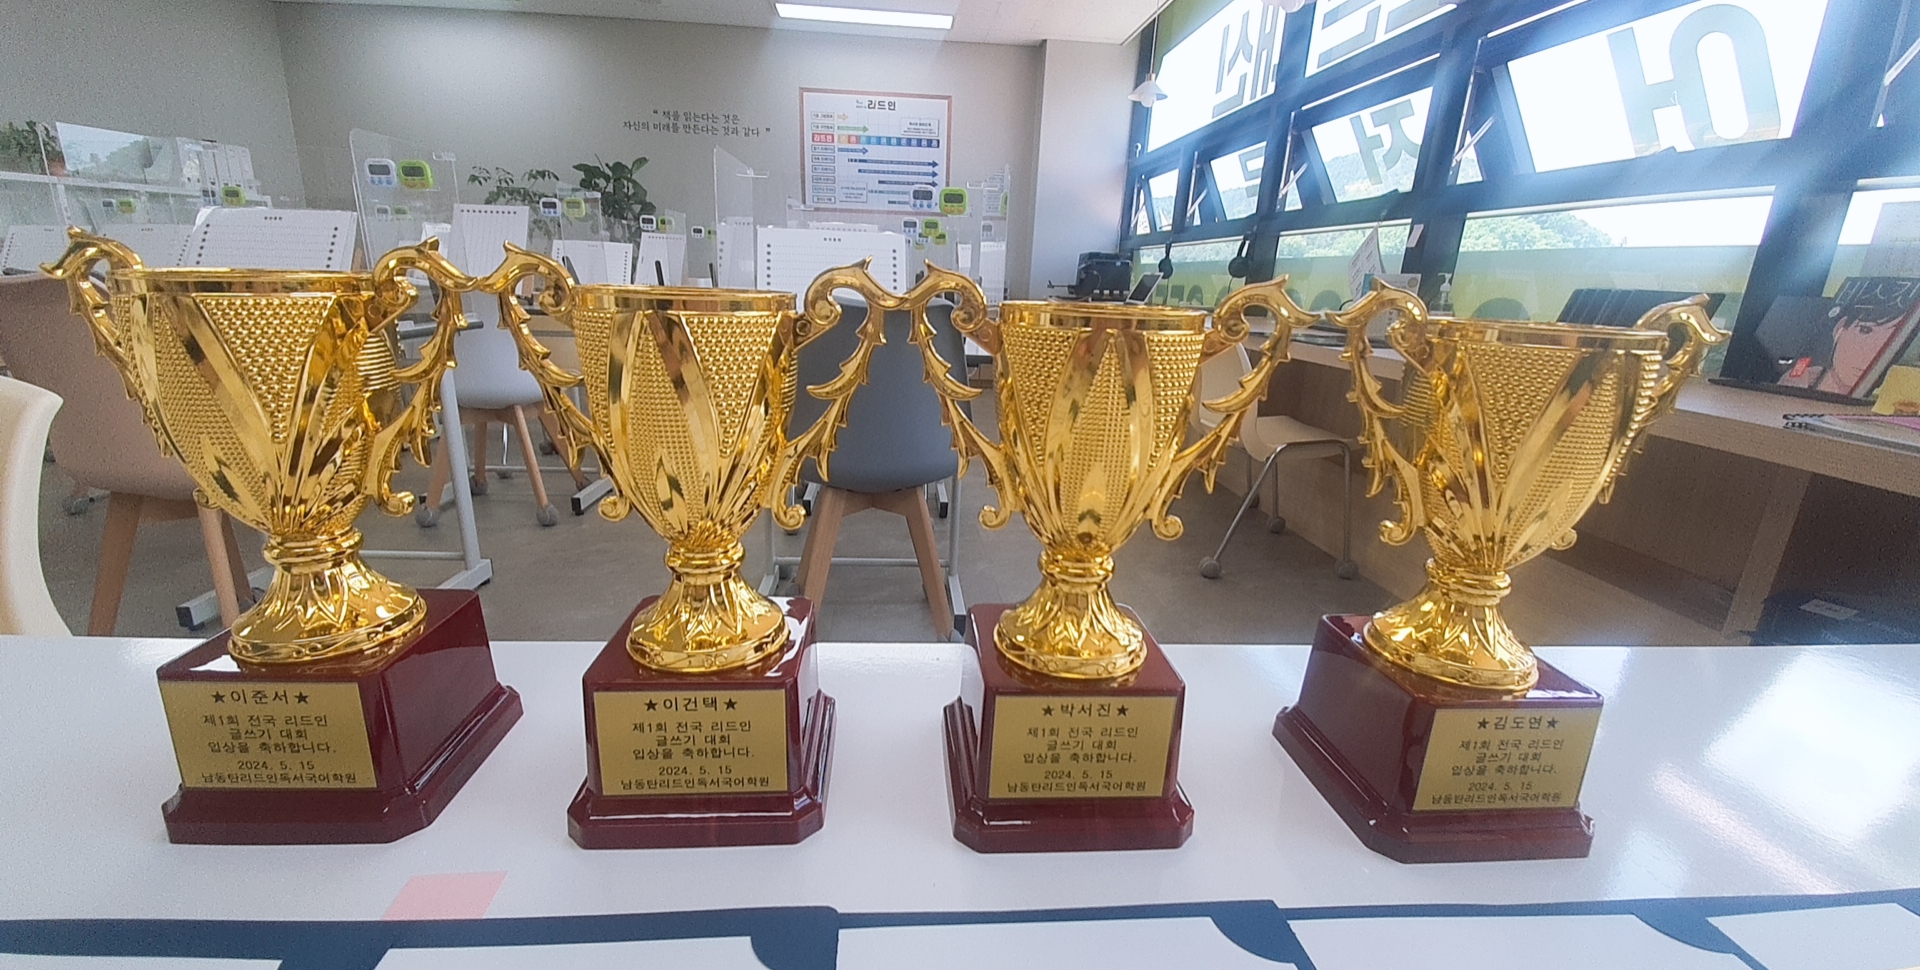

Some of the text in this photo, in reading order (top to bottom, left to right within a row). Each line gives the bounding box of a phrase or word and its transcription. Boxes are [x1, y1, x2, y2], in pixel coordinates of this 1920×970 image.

[867, 100, 896, 111] 리드인
[662, 110, 680, 122] 책을
[683, 112, 720, 124] 읽는다는
[722, 114, 740, 125] 것은
[622, 120, 650, 132] 자신의
[652, 122, 680, 134] 미래를
[682, 124, 720, 136] 만든다는
[722, 126, 739, 137] 것과
[742, 126, 760, 138] 같다
[230, 689, 290, 705] 이준서
[663, 696, 718, 712] 이건택
[1060, 703, 1112, 718] 박서진
[203, 714, 328, 728] 제1회 전국 리드인
[632, 720, 752, 734] 제1회 전국 리드인
[1494, 716, 1542, 730] 김도연
[229, 728, 308, 740] 글쓰기 대회
[1027, 727, 1140, 738] 제1회 전국 리드인
[656, 734, 731, 747] 글쓰기 대회
[1047, 740, 1118, 752] 글쓰기 대회
[1459, 739, 1565, 751] 제1회 전국 리드인
[208, 742, 337, 754] 입상을 축하합니다.
[632, 747, 755, 761] 입상을 축하합니다.
[1023, 752, 1137, 764] 입상을 축하합니다.
[1476, 752, 1542, 764] 글쓰기 대회
[238, 761, 316, 771] 2024. 5. 15
[658, 766, 732, 776] 2024. 5. 15
[1451, 765, 1557, 777] 입상을 축하합니다.
[201, 773, 358, 784] 남동탄리드인독서국어학원
[1044, 770, 1113, 780] 2024. 5. 15
[620, 776, 770, 790] 남동탄리드인독서국어학원
[1007, 782, 1147, 793] 남동탄리드인독서국어학원
[1468, 782, 1533, 792] 2024. 5. 15
[1432, 793, 1562, 805] 남동탄리드인독서국어학원
